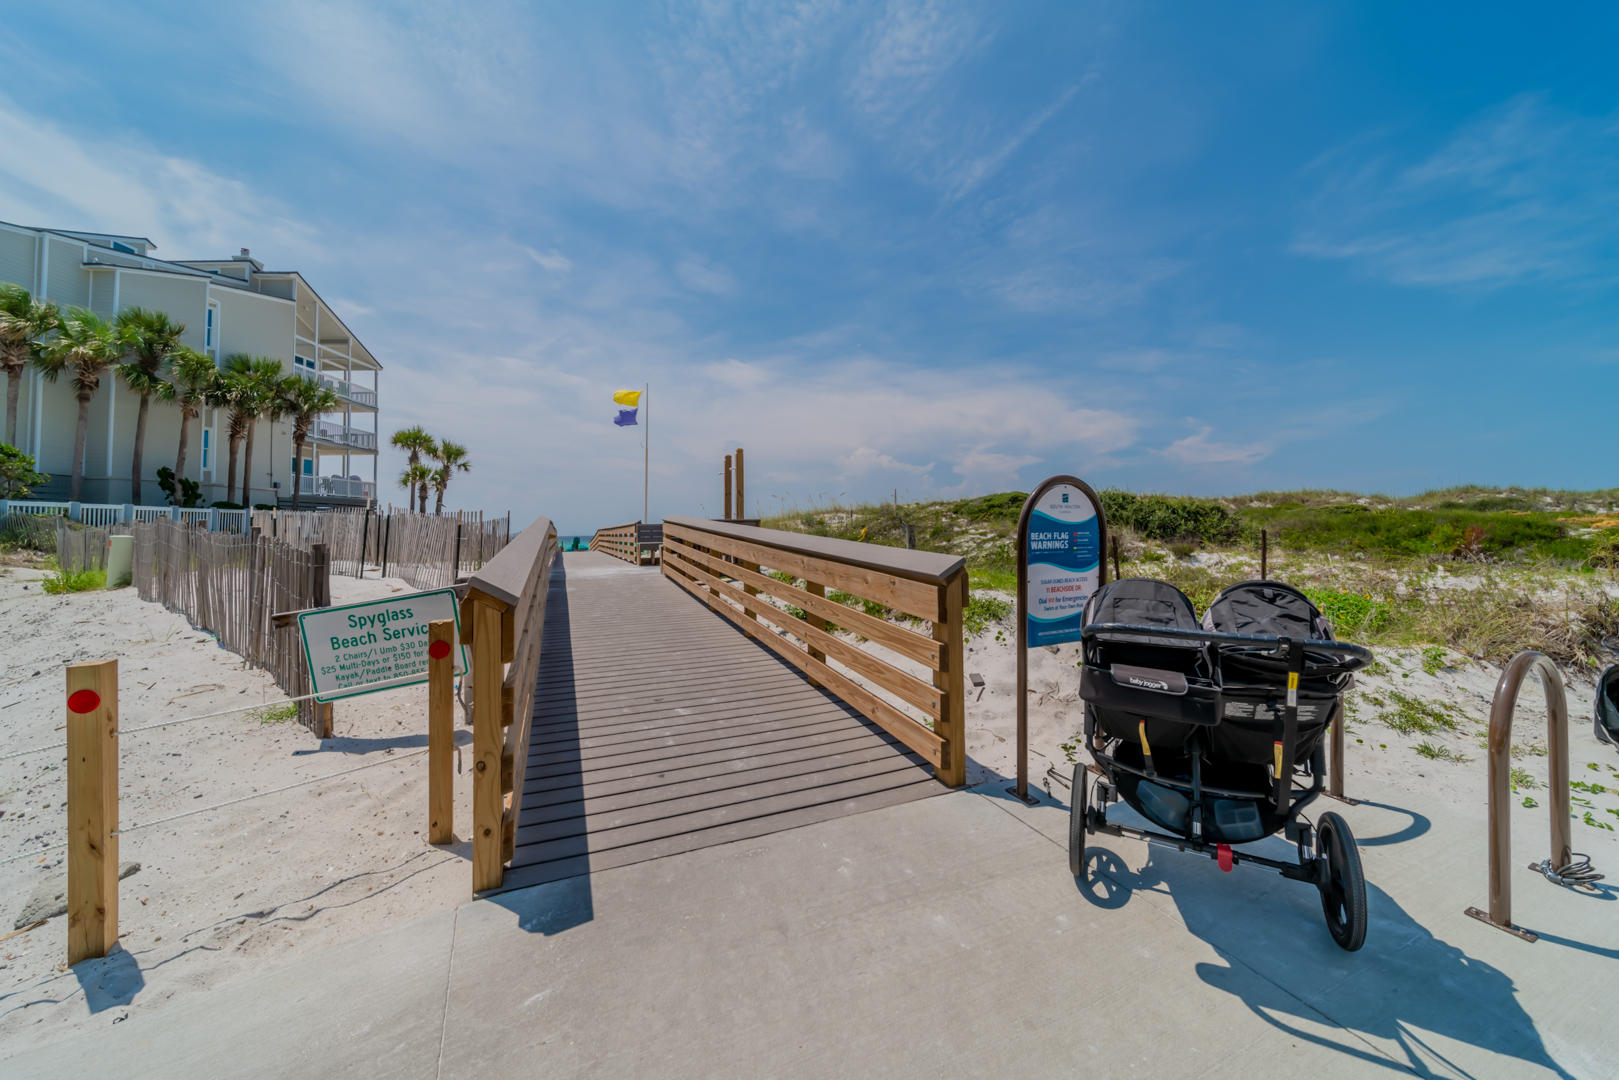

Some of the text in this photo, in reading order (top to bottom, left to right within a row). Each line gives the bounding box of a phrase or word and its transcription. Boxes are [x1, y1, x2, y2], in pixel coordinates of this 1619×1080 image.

[1030, 532, 1052, 540] BEACH
[1054, 532, 1069, 540] FLAG
[1030, 540, 1069, 550] WARNINGS
[348, 608, 414, 630] Spyglass
[330, 622, 429, 650] Beach Servic
[379, 646, 398, 654] Umb
[400, 642, 415, 651] $30
[418, 640, 428, 648] Da
[320, 666, 337, 676] $25
[339, 659, 380, 671] Multi-Days
[393, 652, 411, 662] $150
[335, 665, 392, 682] Kayak/Paddle
[395, 660, 416, 670] Board
[1129, 677, 1143, 686] baby
